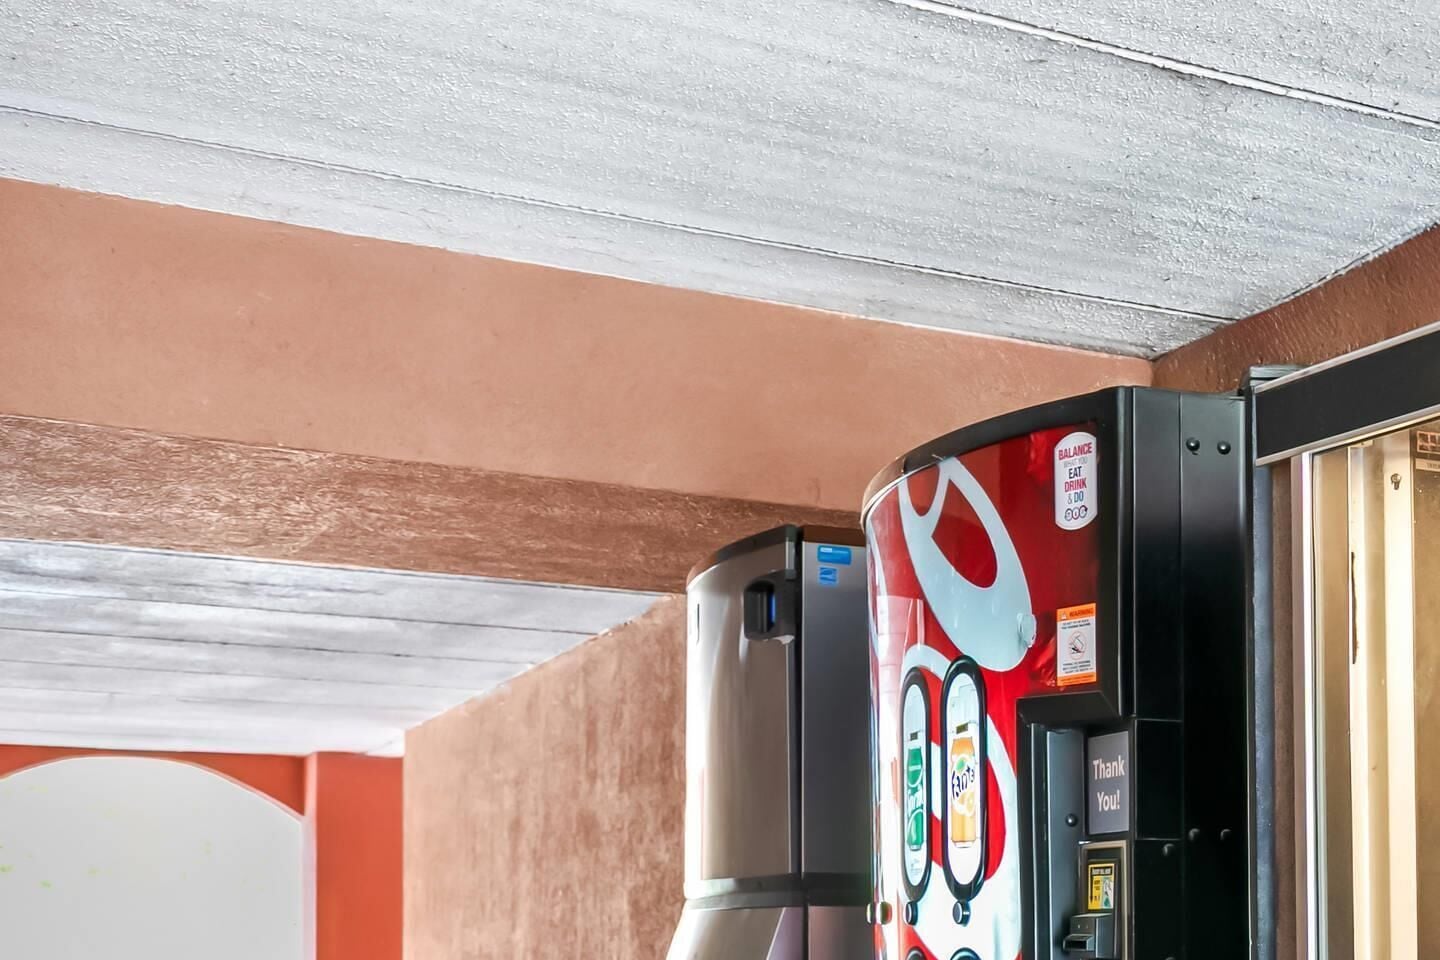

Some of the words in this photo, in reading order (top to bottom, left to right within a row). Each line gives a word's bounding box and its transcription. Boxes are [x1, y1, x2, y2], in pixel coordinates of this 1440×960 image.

[1058, 442, 1093, 460] BALANCE
[1068, 466, 1082, 479] EAT
[1064, 478, 1087, 493] DRINK
[1074, 491, 1084, 503] DO
[1092, 755, 1125, 780] Thank
[1096, 789, 1121, 812] You!
